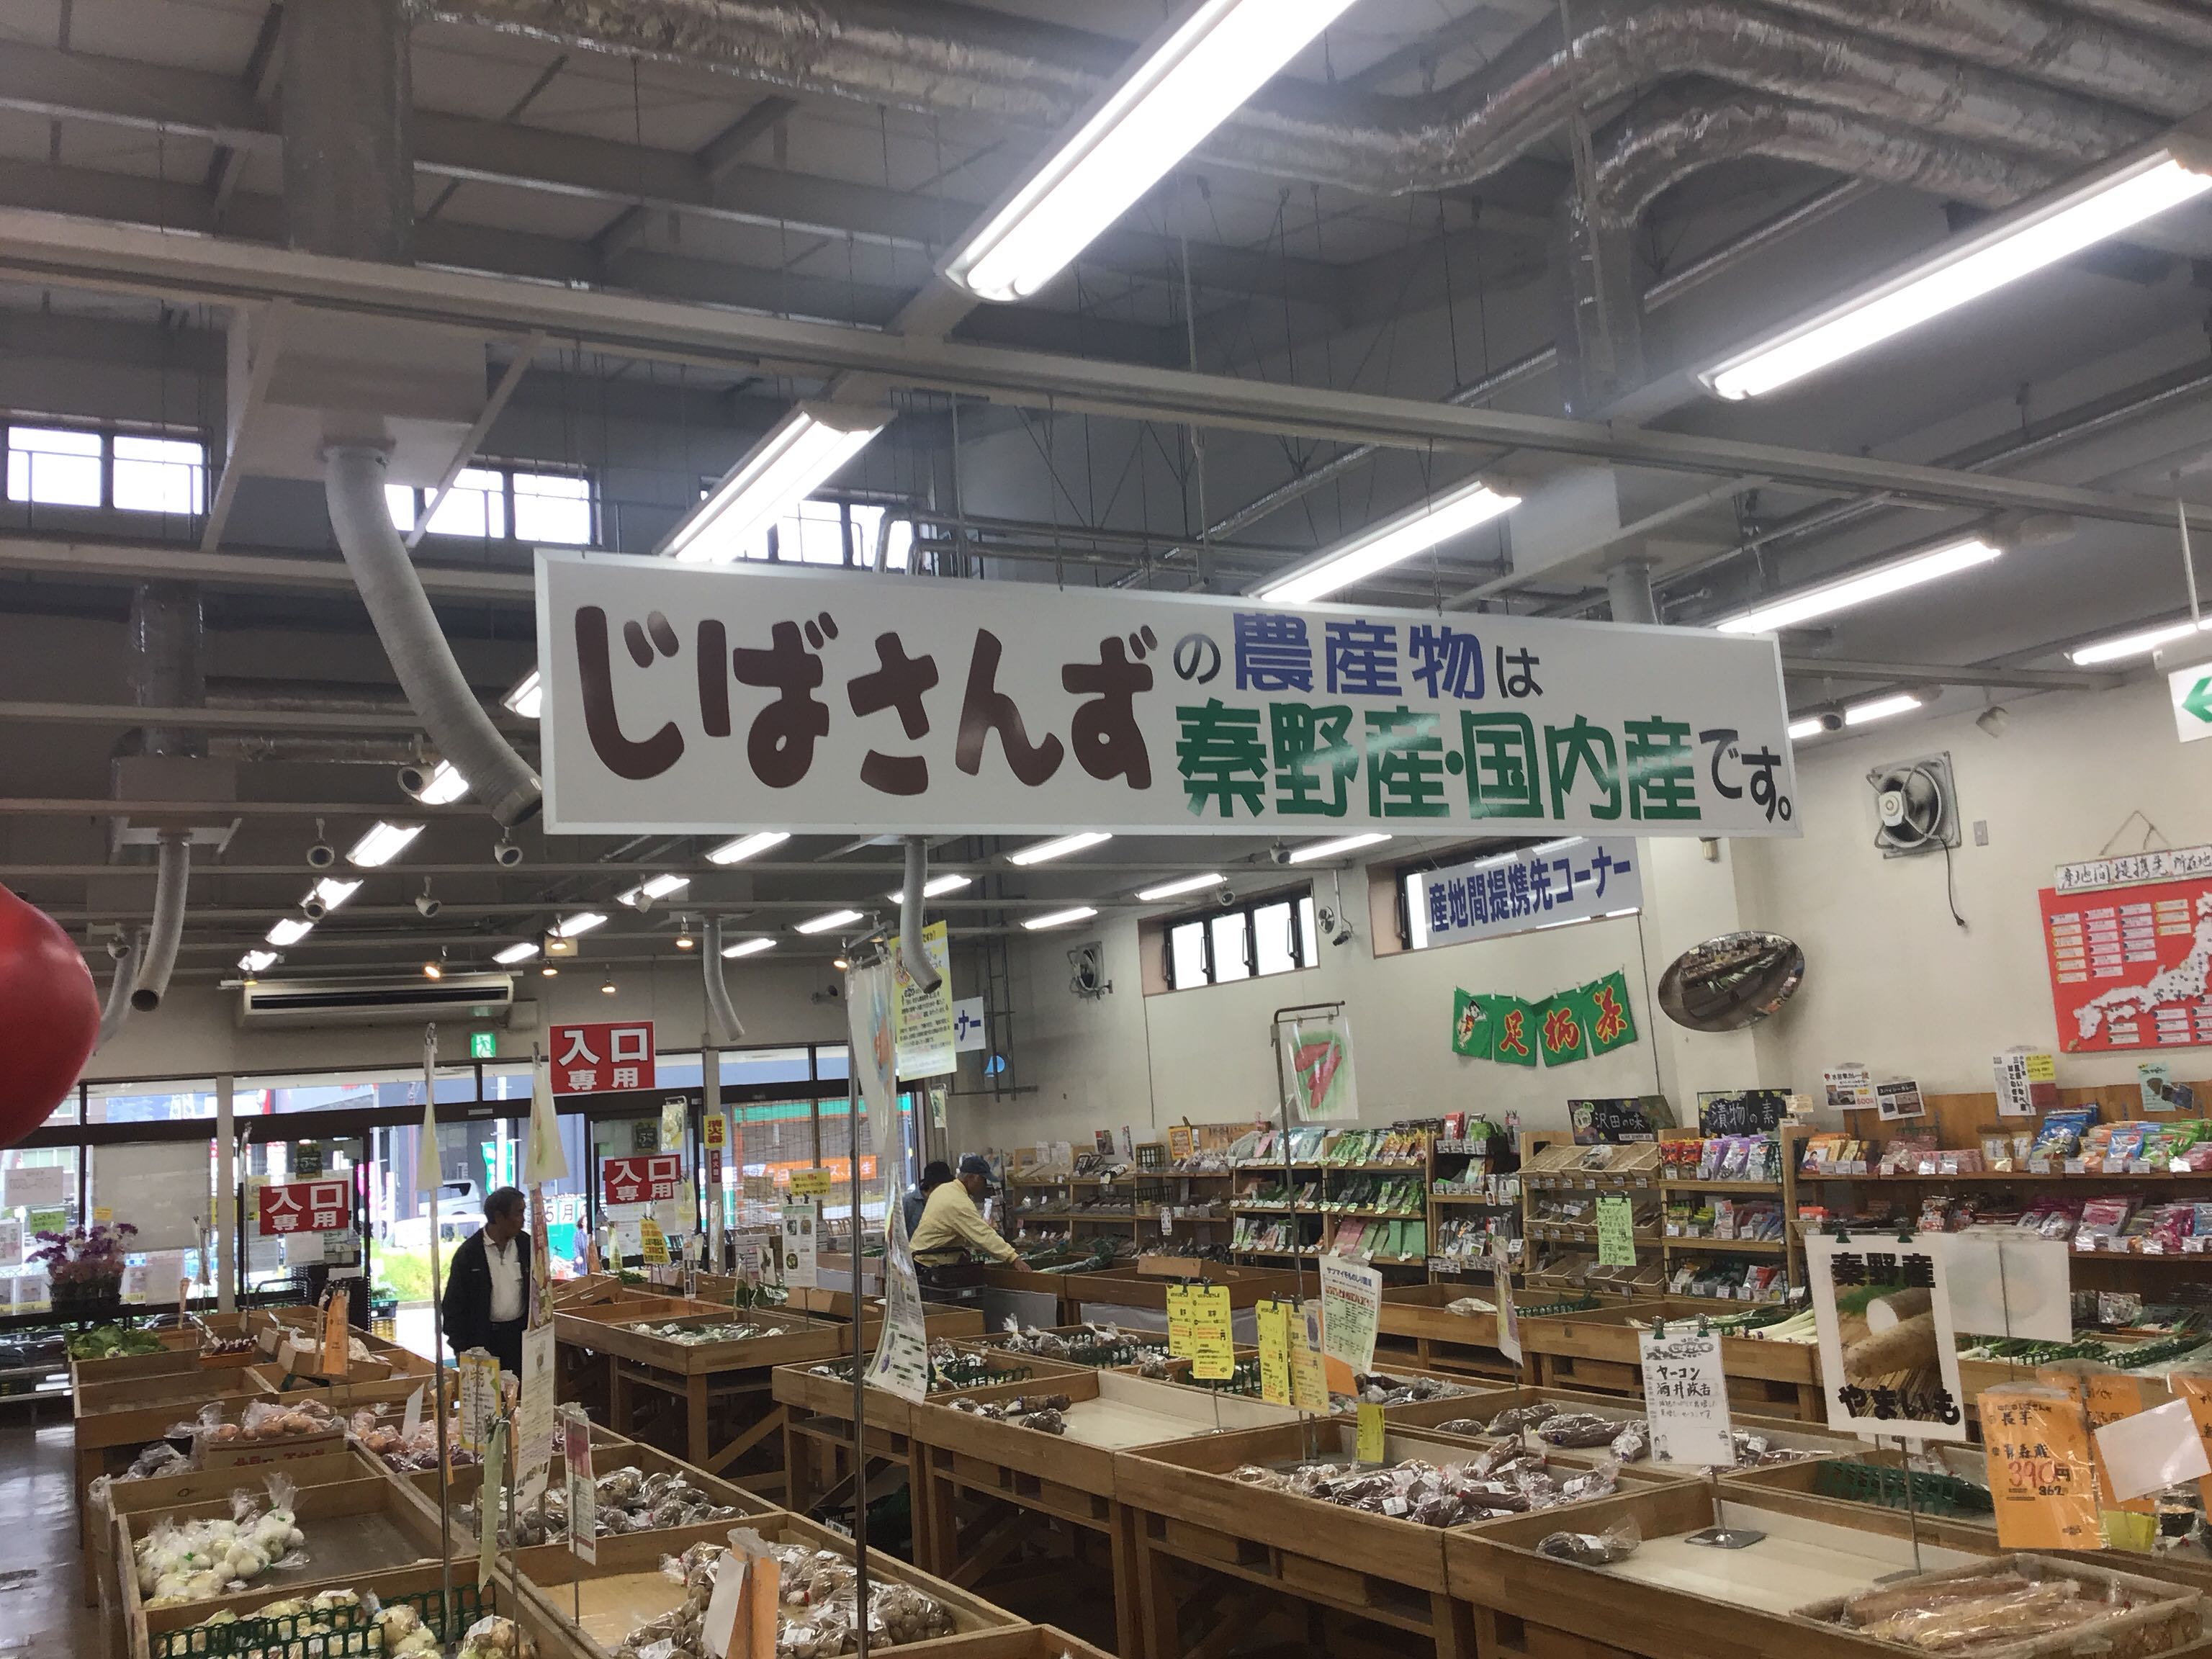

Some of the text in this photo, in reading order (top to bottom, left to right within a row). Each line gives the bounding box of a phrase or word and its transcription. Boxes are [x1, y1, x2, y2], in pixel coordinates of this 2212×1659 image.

[1173, 613, 1544, 700] の農産物は
[575, 605, 1159, 796] じばさんず
[1429, 845, 1632, 934] 産地間提携先コーナー
[954, 1010, 981, 1041] ナー
[1498, 984, 1627, 1057] 足柄茶
[558, 1028, 648, 1067] 入口
[567, 1067, 639, 1091] 専用
[1594, 1111, 1645, 1131] 沢田の味
[1712, 1099, 1775, 1128] 漬物の素
[611, 1157, 677, 1185] 入口
[266, 1184, 343, 1214] 入口
[616, 1182, 672, 1202] 専用
[272, 1210, 337, 1231] 専用
[1830, 1251, 1936, 1288] 秦野産
[1657, 1365, 1700, 1380] ヤーコン
[1838, 1383, 1961, 1426] やまいも
